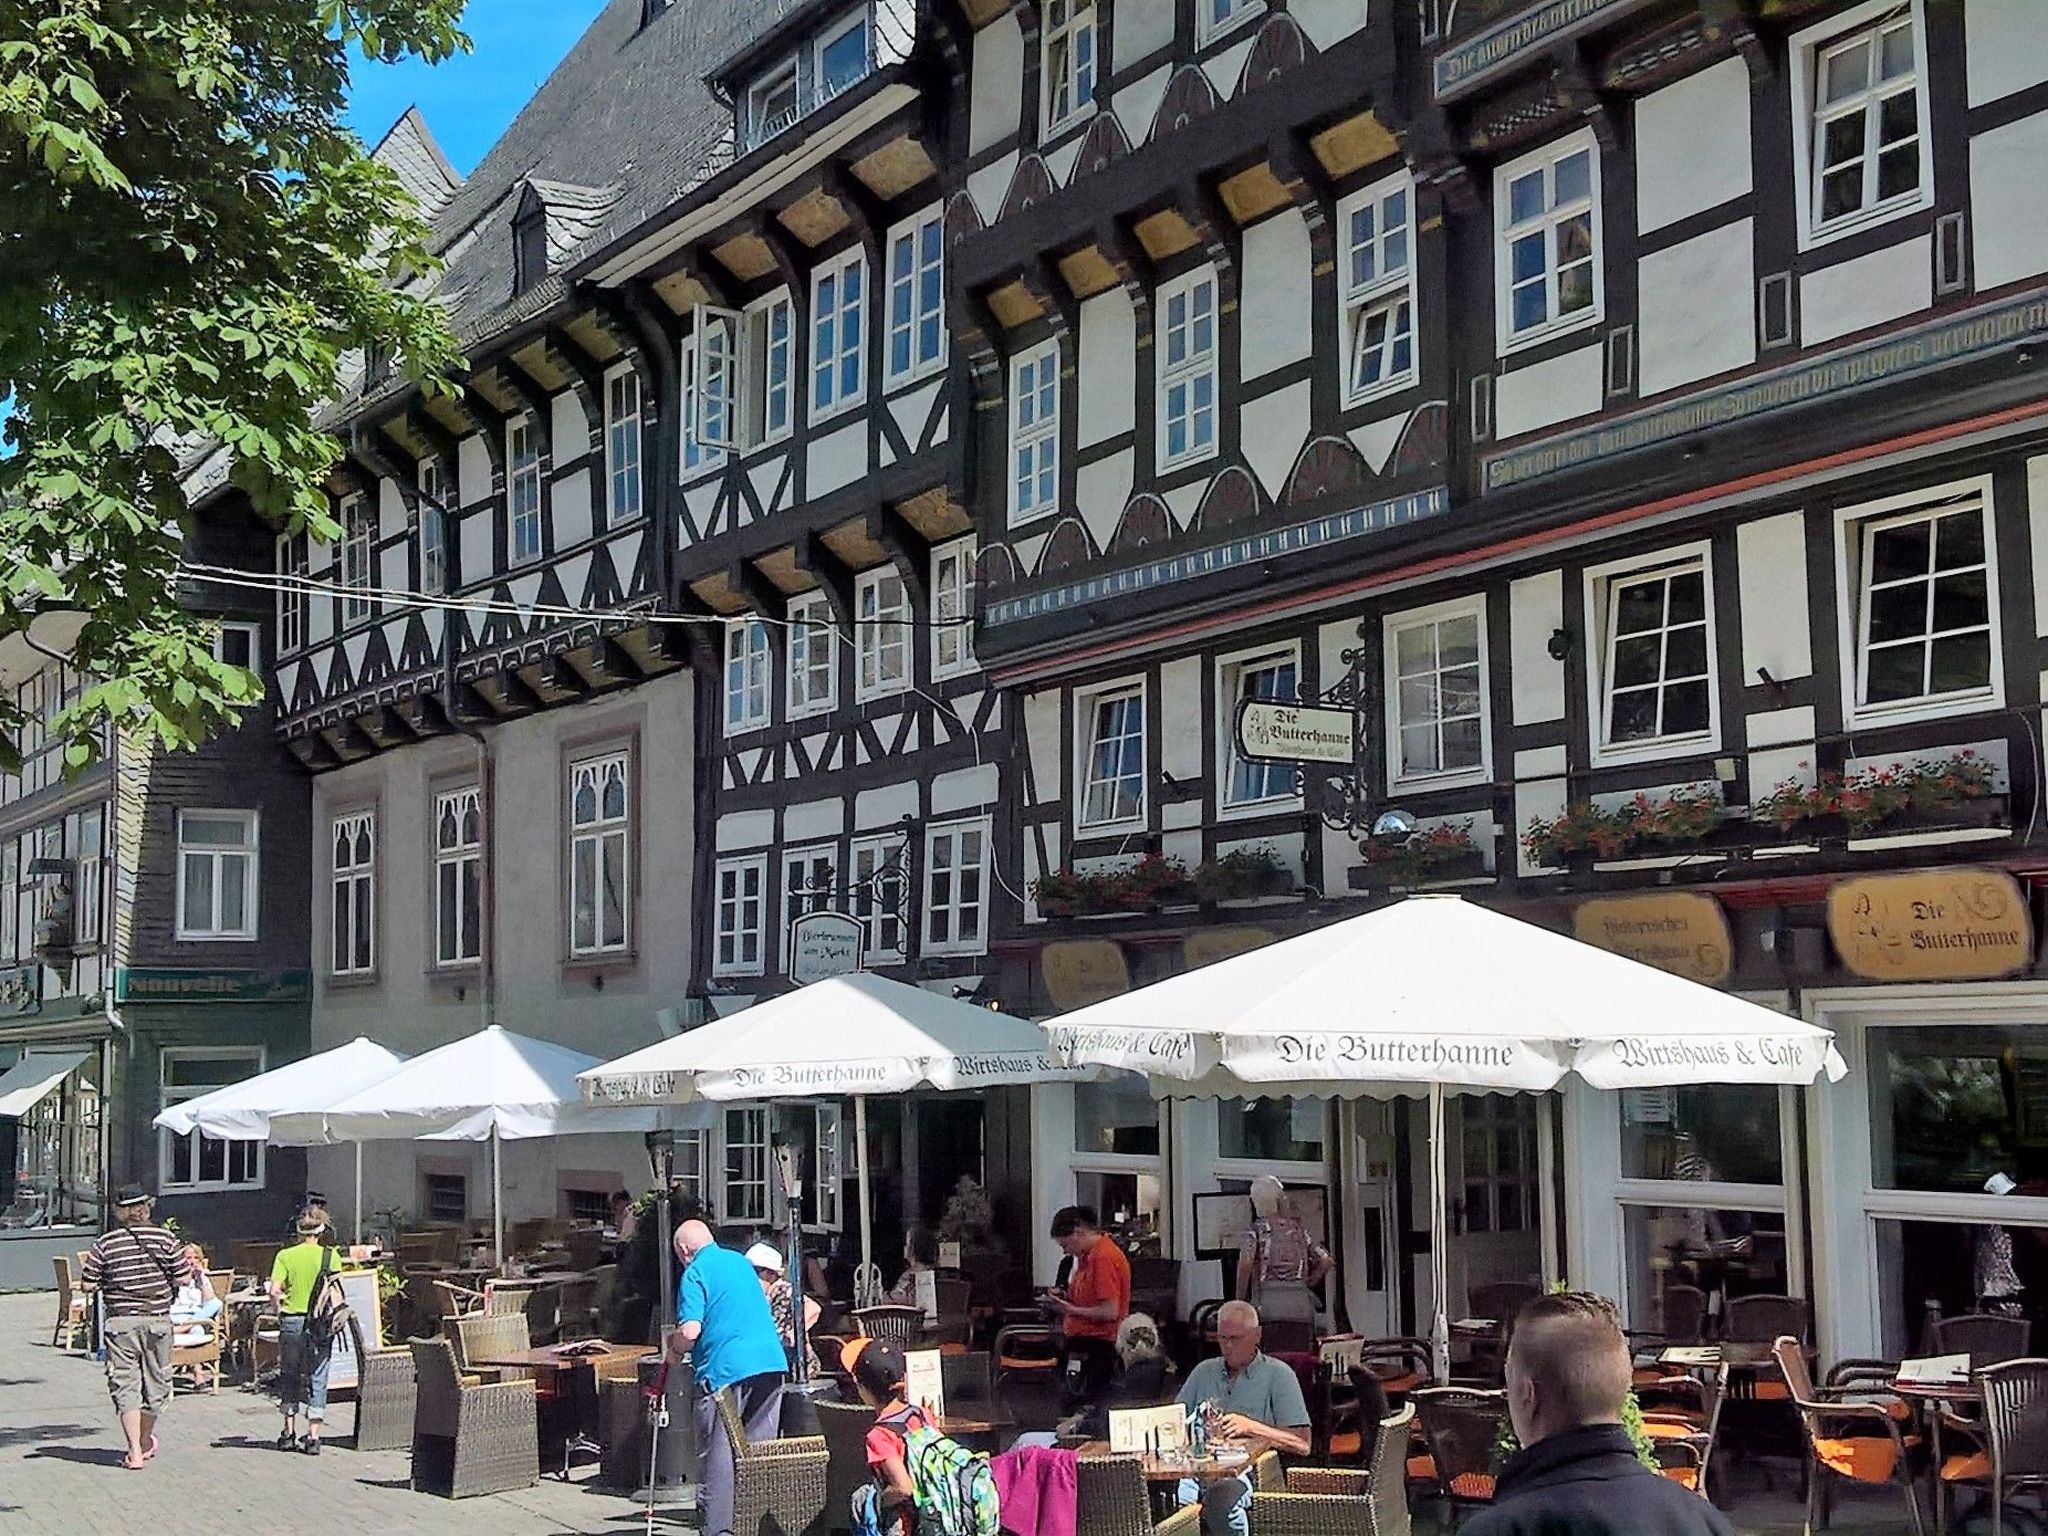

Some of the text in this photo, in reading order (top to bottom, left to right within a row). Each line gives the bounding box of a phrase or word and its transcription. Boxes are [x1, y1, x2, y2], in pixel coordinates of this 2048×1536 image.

[1274, 709, 1299, 724] Die
[1269, 725, 1351, 744] Butterhanne
[1911, 900, 1945, 920] Die
[1910, 928, 2019, 952] Butterhanne
[1274, 1035, 1513, 1069] Die Butterhanne
[1612, 1037, 1731, 1070] Wirtshaus
[1736, 1039, 1756, 1065] &
[952, 1055, 1033, 1076] Wirtshaus
[1036, 1054, 1052, 1071] &
[732, 1065, 887, 1088] Die Butterhanne
